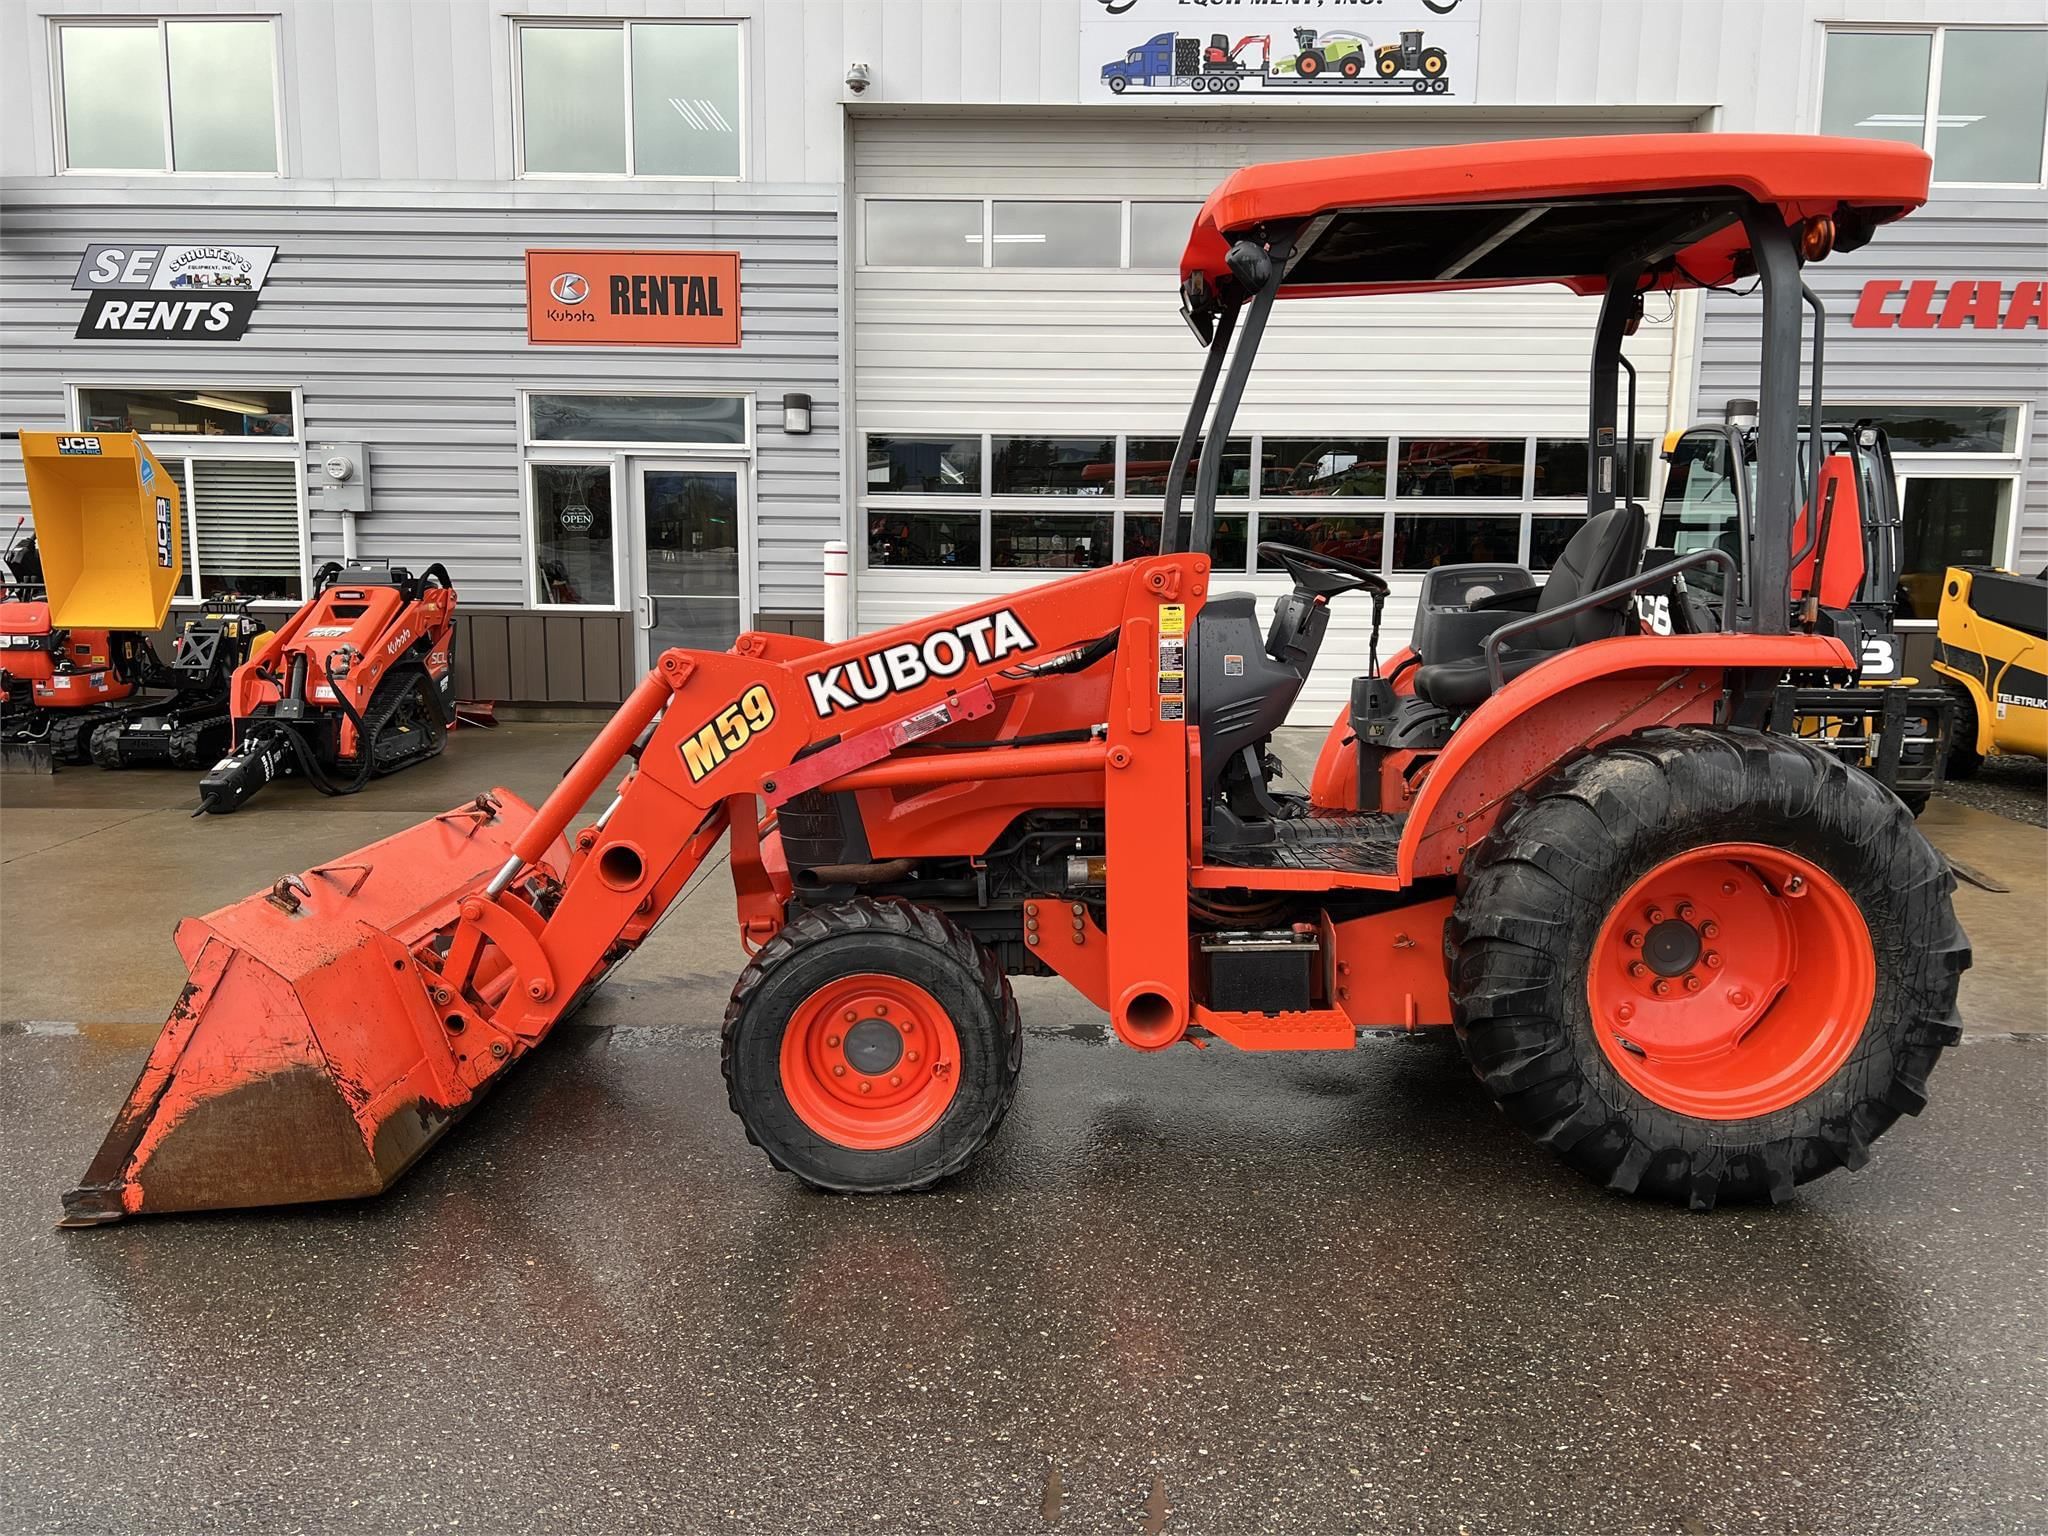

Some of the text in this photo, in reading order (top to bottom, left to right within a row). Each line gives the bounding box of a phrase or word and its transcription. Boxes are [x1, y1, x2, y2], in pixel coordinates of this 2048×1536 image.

[88, 249, 160, 284] SE
[169, 247, 252, 273] SCHOLTEN'S
[609, 274, 724, 317] RENTAL
[94, 300, 234, 332] RENTS
[546, 309, 596, 322] Kubota
[58, 436, 101, 450] JCB
[156, 498, 168, 566] JCB
[562, 514, 591, 524] OPEN
[387, 628, 411, 655] Kubota
[806, 610, 1036, 716] KUBOTA
[1997, 692, 2048, 709] TELETRUK
[679, 684, 776, 783] M59
